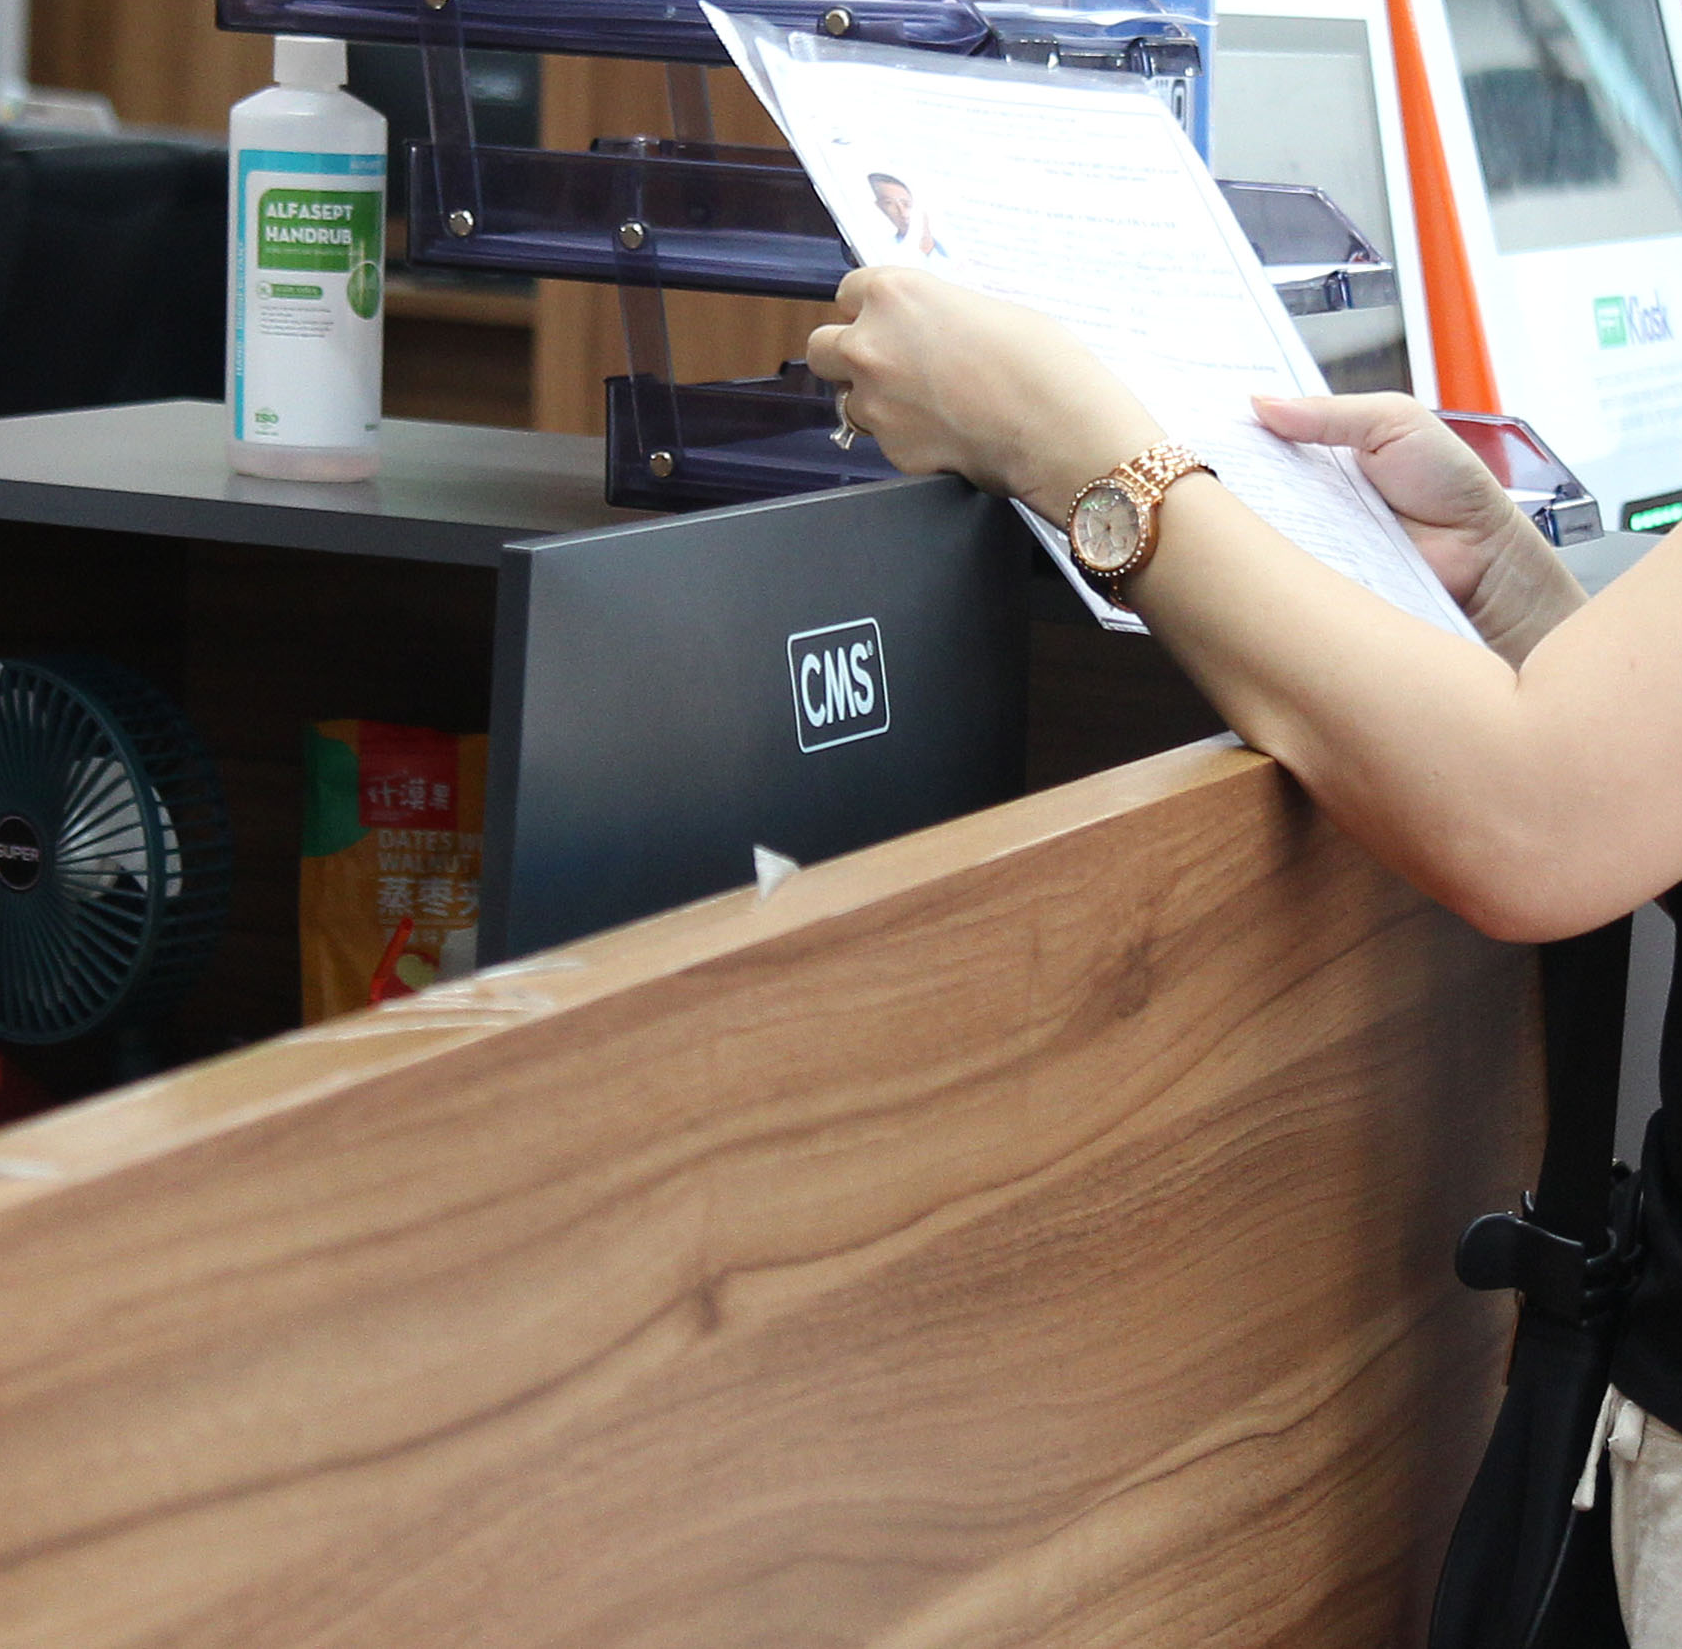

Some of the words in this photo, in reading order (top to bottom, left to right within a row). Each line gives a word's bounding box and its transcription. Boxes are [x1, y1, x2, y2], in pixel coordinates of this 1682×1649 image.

[265, 201, 354, 221] ALFASEPT
[265, 225, 353, 245] HANDRUB
[378, 829, 452, 852] DATES
[378, 853, 473, 874] WALNUT
